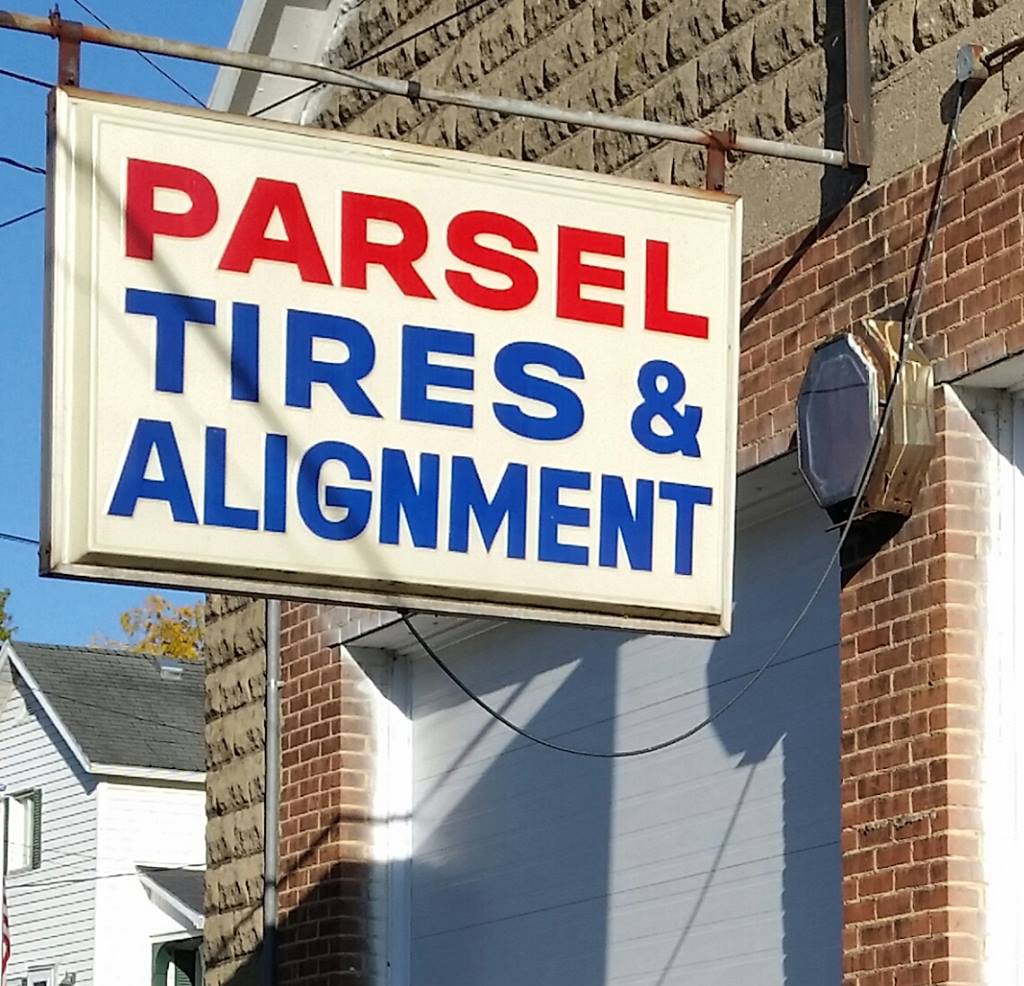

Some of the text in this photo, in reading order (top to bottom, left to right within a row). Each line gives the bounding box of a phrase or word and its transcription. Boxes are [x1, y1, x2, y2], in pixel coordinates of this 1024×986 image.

[125, 157, 710, 339] PARSEL
[125, 287, 702, 458] TIRES &
[106, 418, 714, 576] ALIGNMENT
